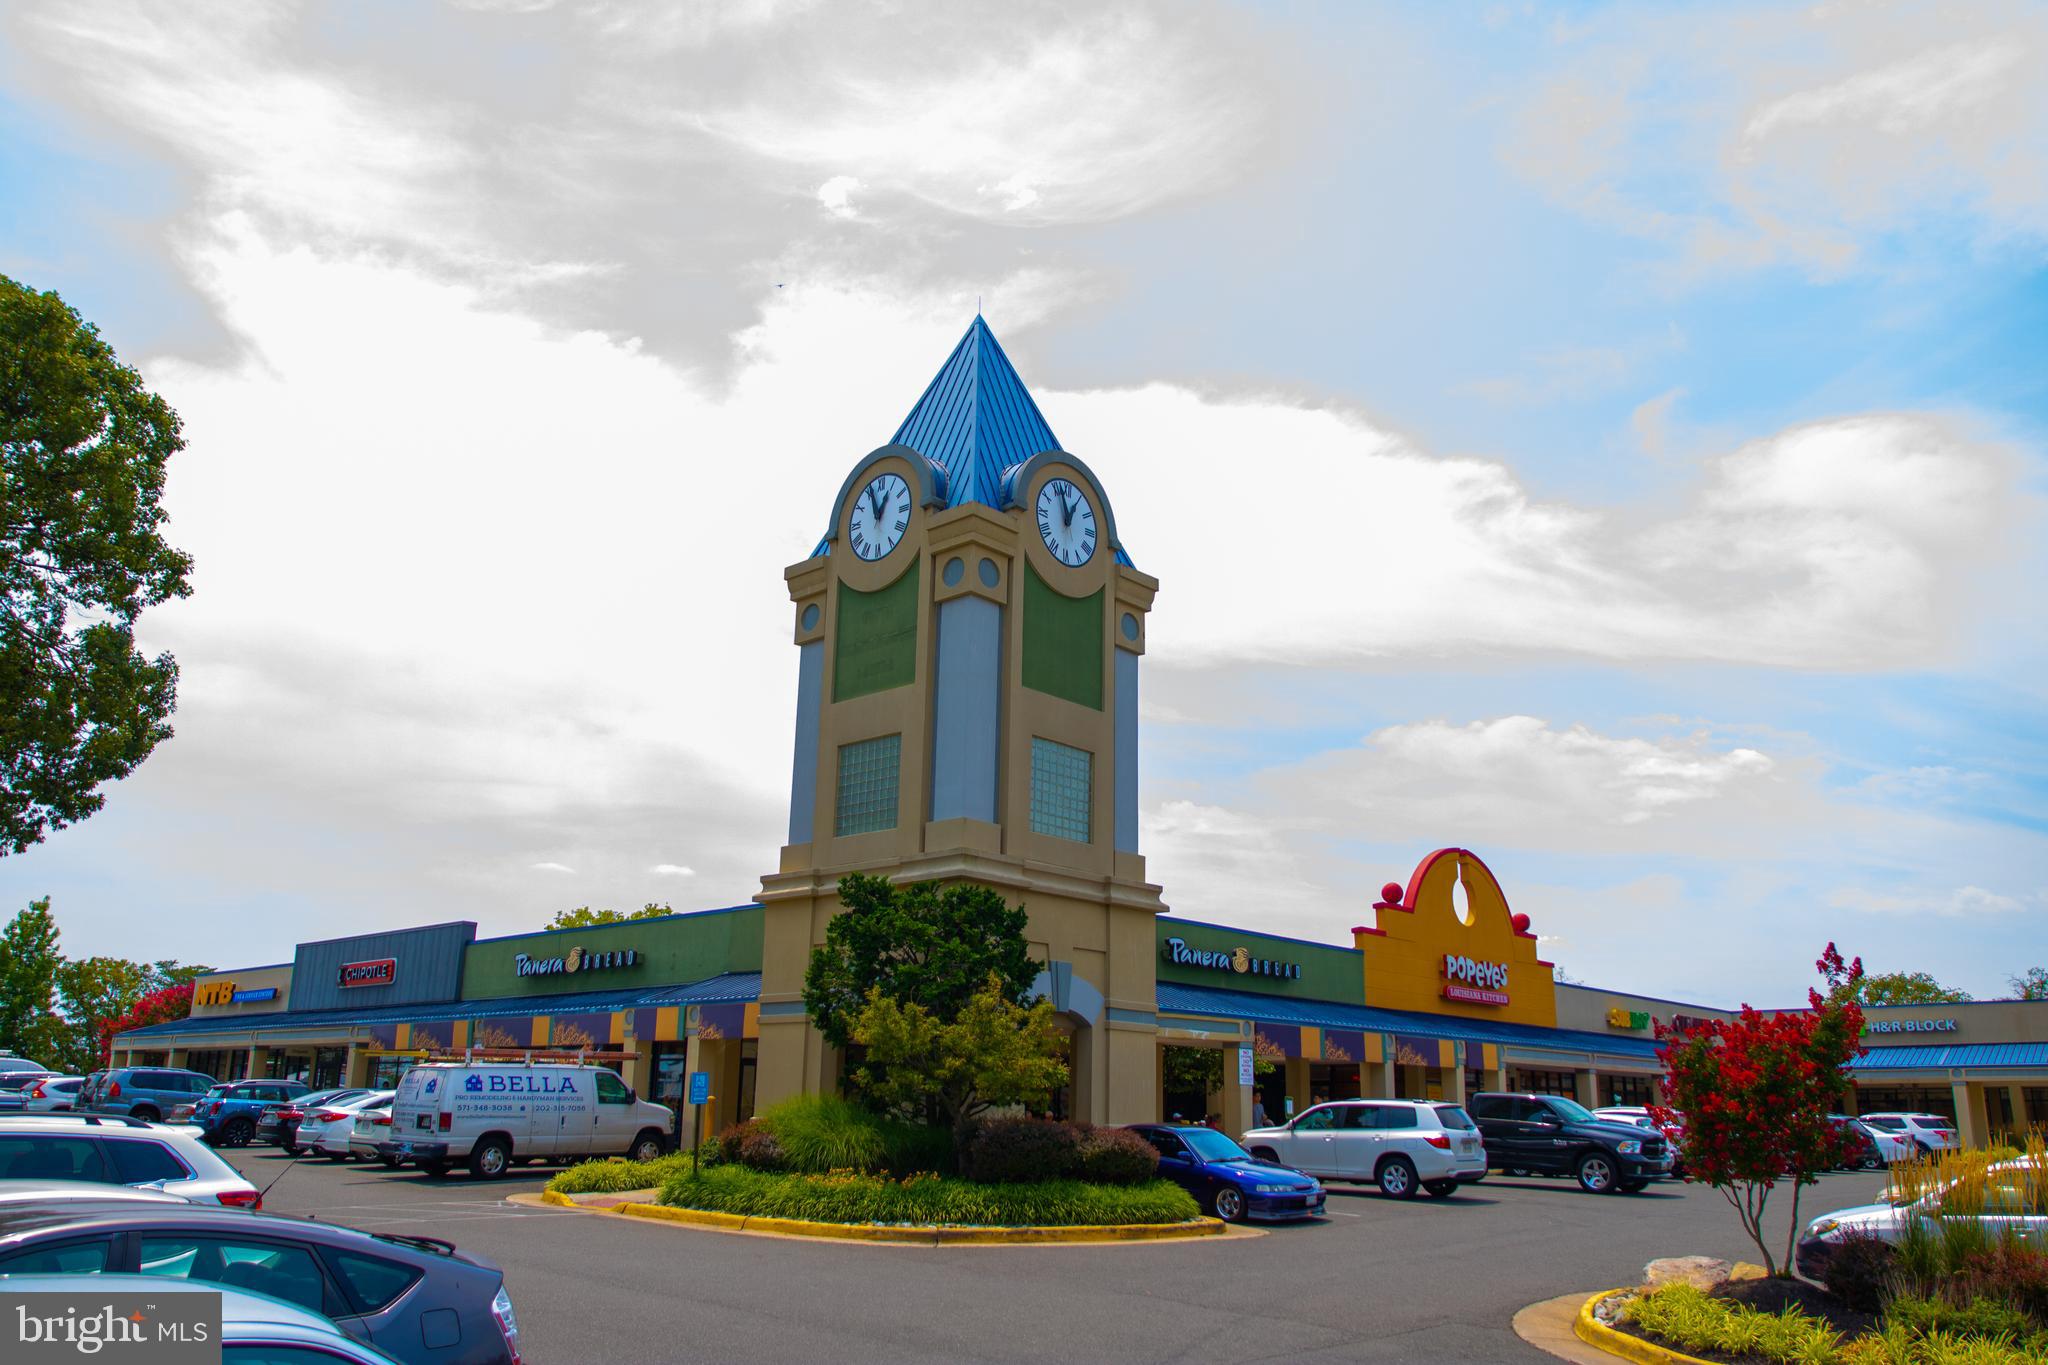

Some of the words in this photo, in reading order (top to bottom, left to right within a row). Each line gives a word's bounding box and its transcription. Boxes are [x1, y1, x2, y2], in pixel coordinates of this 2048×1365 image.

[514, 952, 563, 977] Panera
[583, 949, 635, 970] BREAD
[1168, 937, 1231, 970] Panera
[1252, 958, 1302, 979] BREAD
[345, 964, 388, 980] CHIPOTLE
[194, 980, 237, 1007] NTB
[1482, 991, 1509, 1004] KITCHEN
[1869, 1020, 1902, 1033] H&R
[1904, 1018, 1957, 1032] BLOCK
[488, 1075, 578, 1093] BELLA
